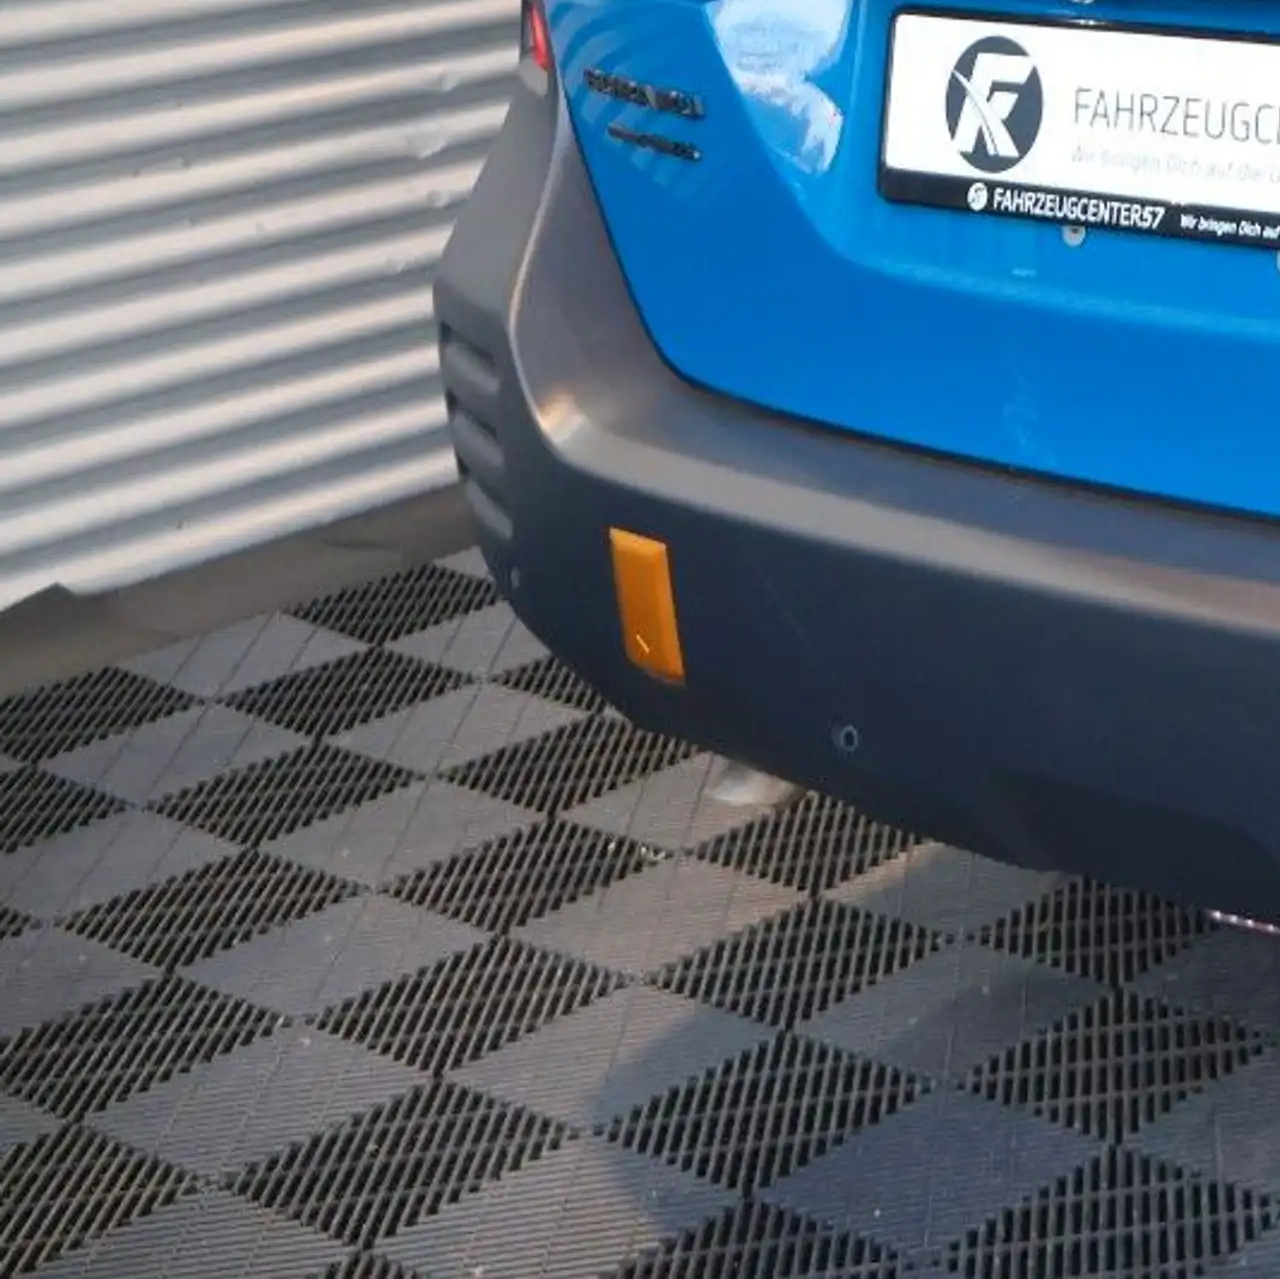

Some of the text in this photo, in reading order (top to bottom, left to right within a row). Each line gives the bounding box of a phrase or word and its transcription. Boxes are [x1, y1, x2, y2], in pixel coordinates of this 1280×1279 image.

[993, 186, 1165, 230] FAHRZEUGCENTER57
[1198, 215, 1238, 237] bringen
[1238, 219, 1261, 237] Dich
